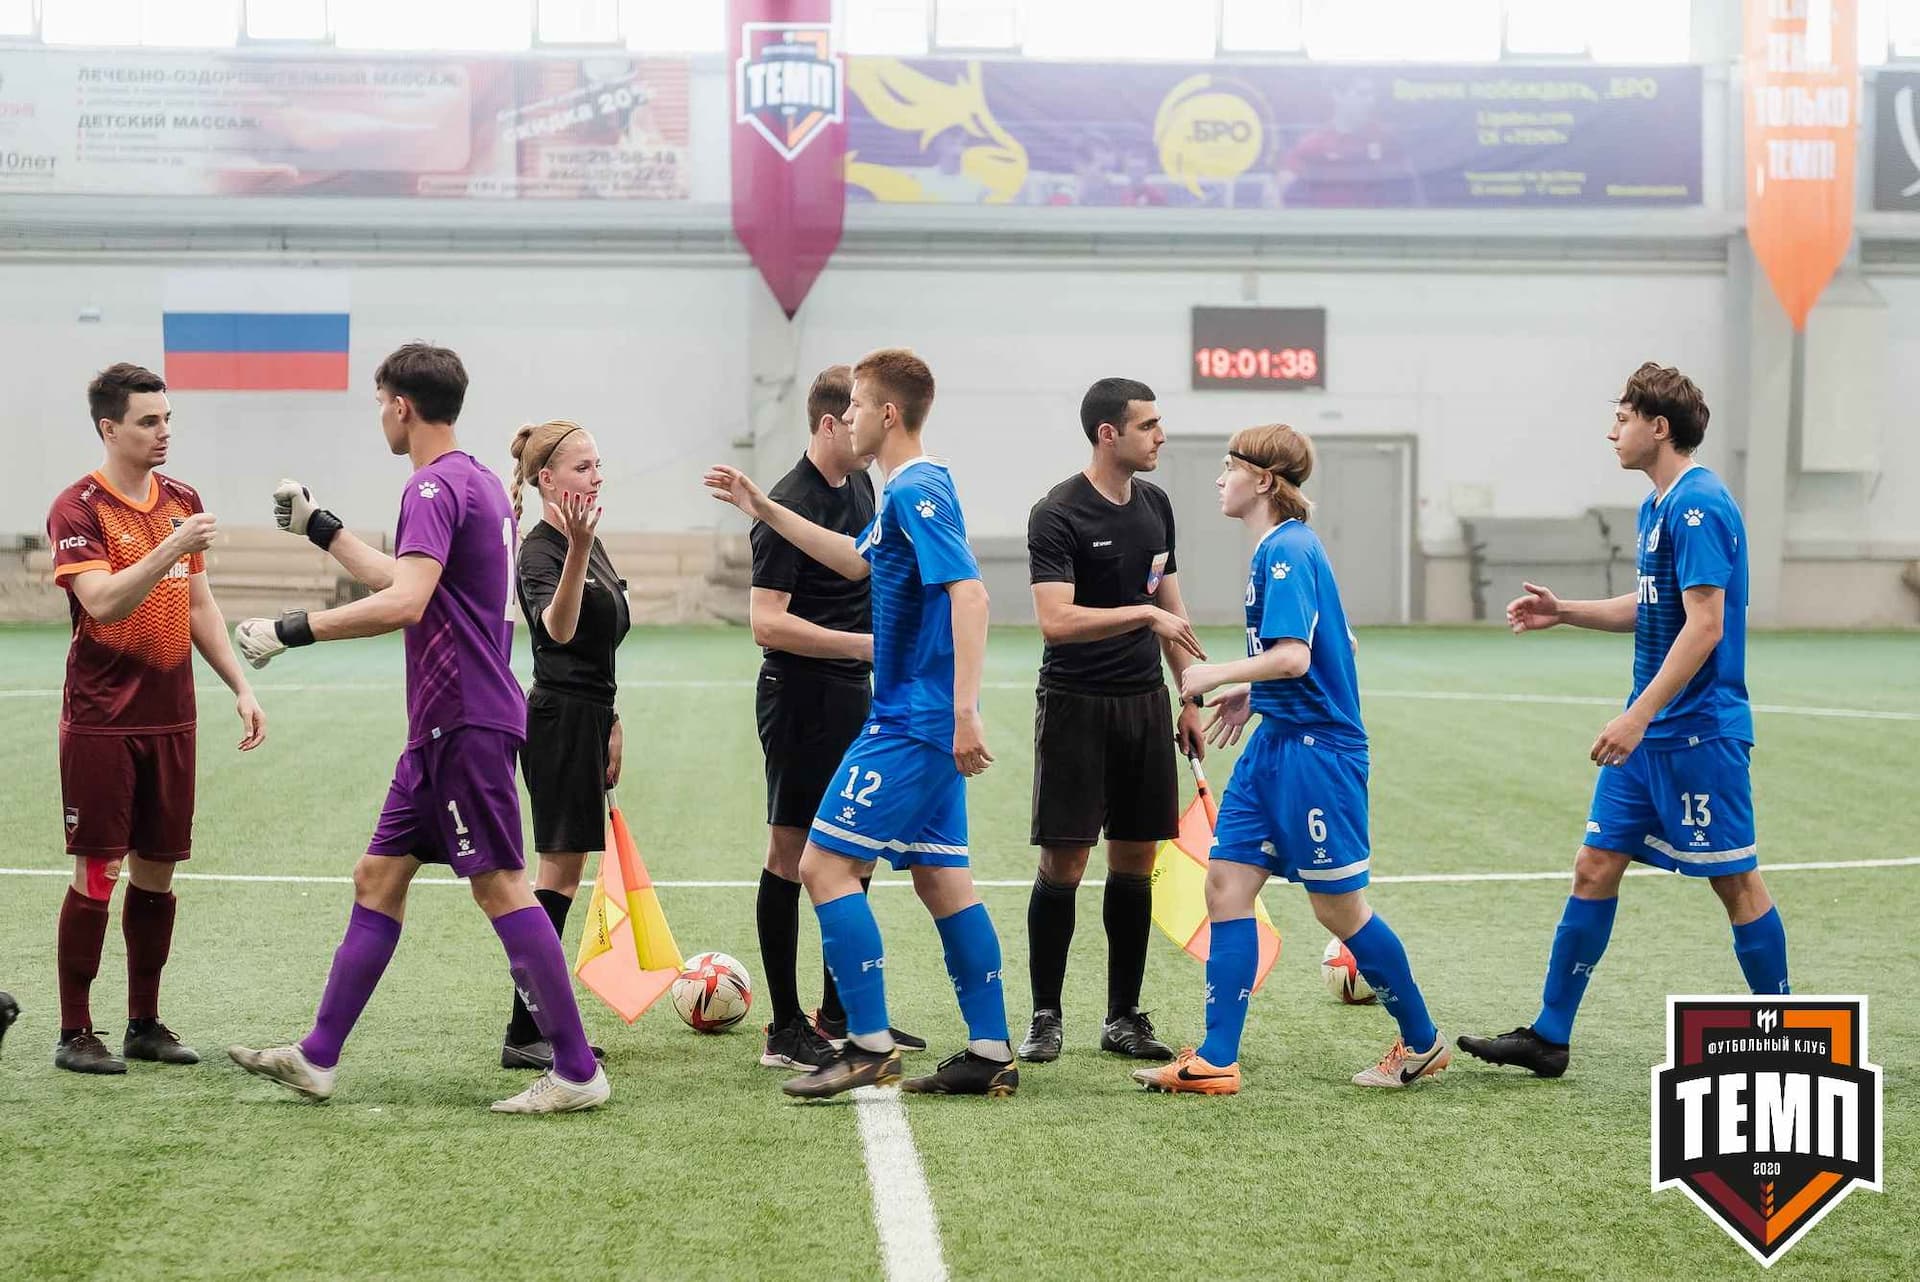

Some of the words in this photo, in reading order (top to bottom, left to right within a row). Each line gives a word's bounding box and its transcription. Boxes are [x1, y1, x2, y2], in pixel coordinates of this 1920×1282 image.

[746, 61, 833, 108] ТЕМП
[77, 112, 166, 130] ДЕТСКИЙ
[1754, 85, 1849, 128] ТОЛЬКО
[1183, 119, 1252, 143] .БРО
[1195, 347, 1318, 379] 19:01:38
[59, 535, 88, 550] ПСБ
[840, 766, 883, 808] 12
[447, 799, 469, 835] 1
[1307, 808, 1328, 843] 6
[1681, 792, 1712, 827] 13
